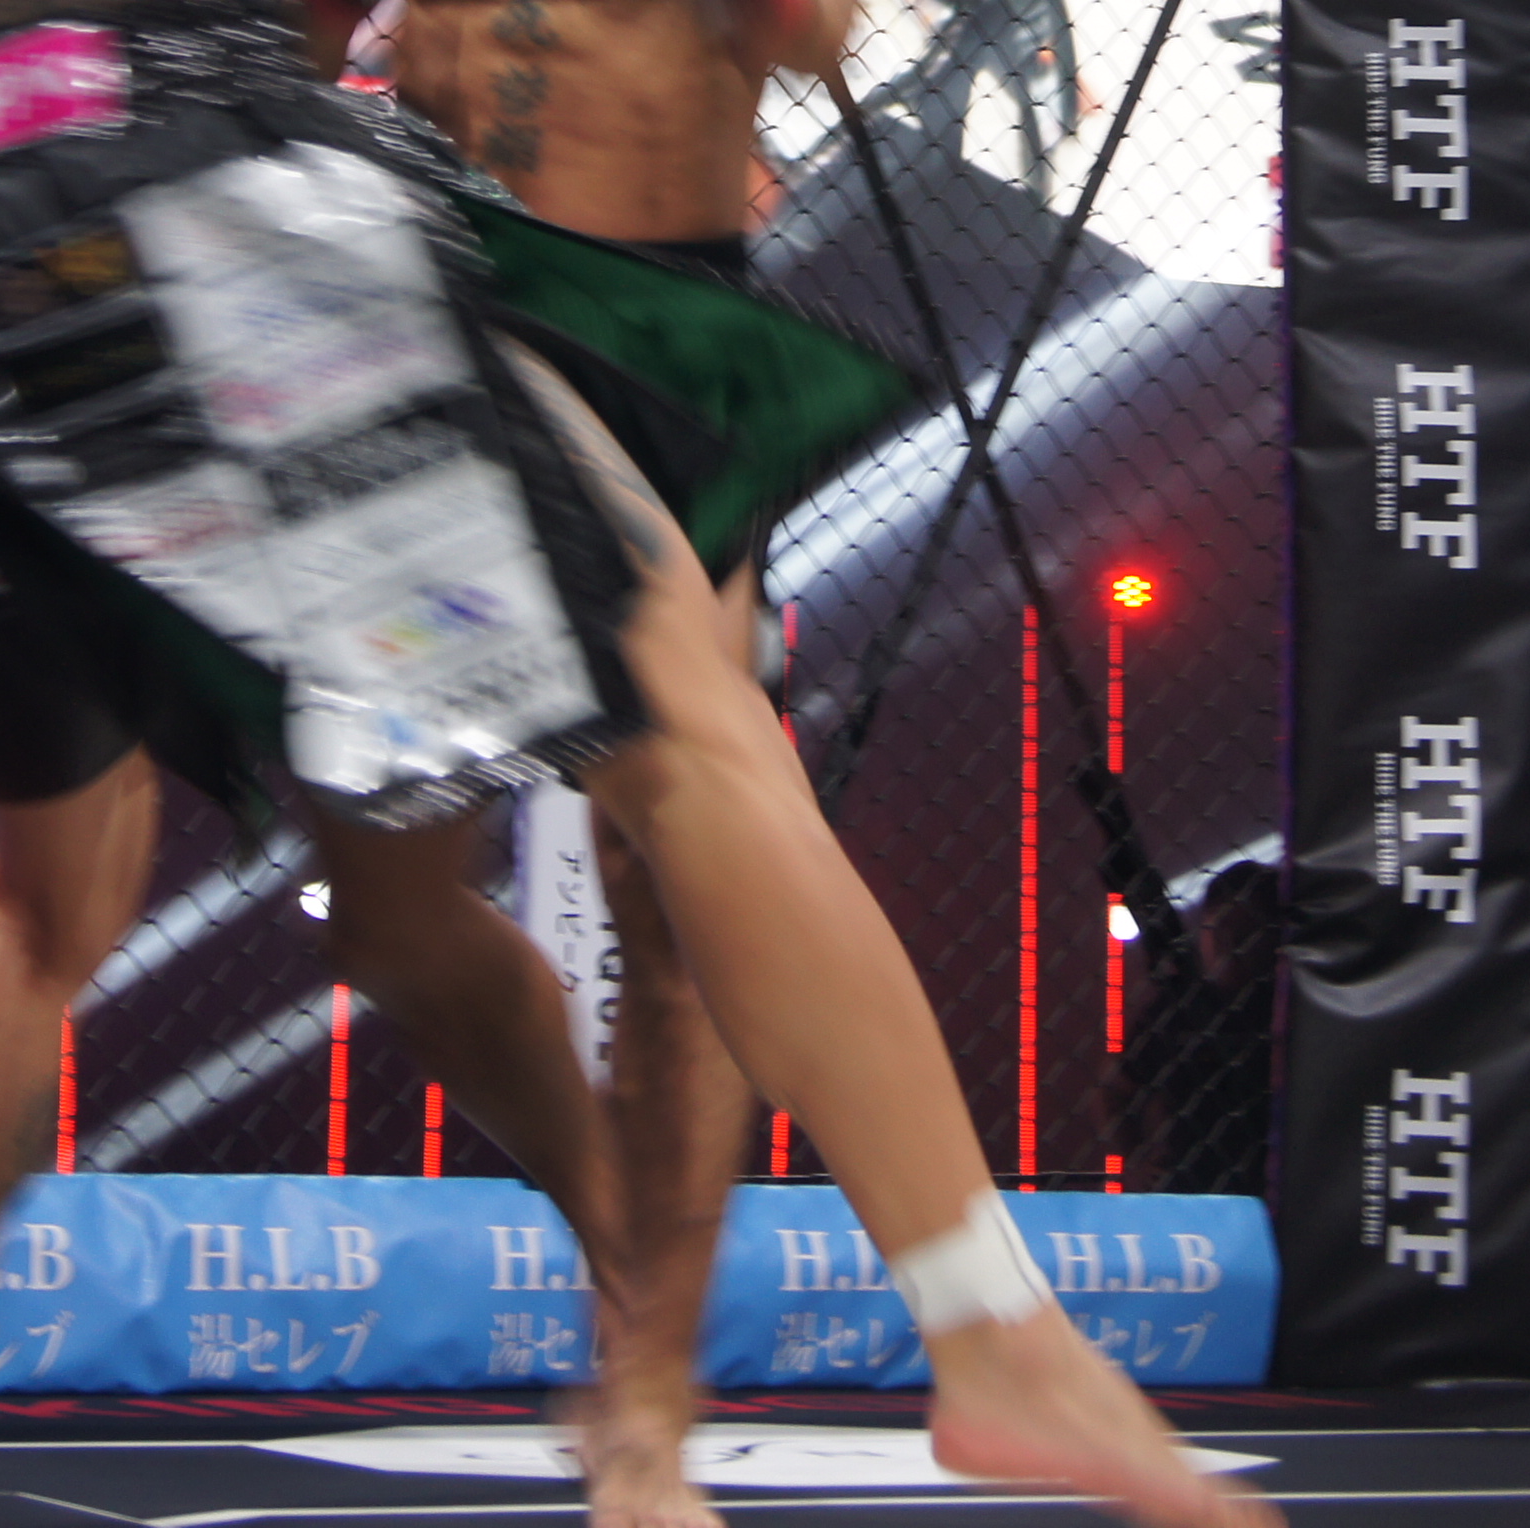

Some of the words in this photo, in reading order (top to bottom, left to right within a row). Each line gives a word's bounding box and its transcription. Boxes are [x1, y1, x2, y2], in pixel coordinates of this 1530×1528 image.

[1388, 18, 1469, 221] HTF
[1395, 363, 1479, 569] HTF
[1400, 715, 1482, 923] HTF
[184, 1223, 383, 1292] H.L.B
[1386, 1068, 1472, 1287] HTF
